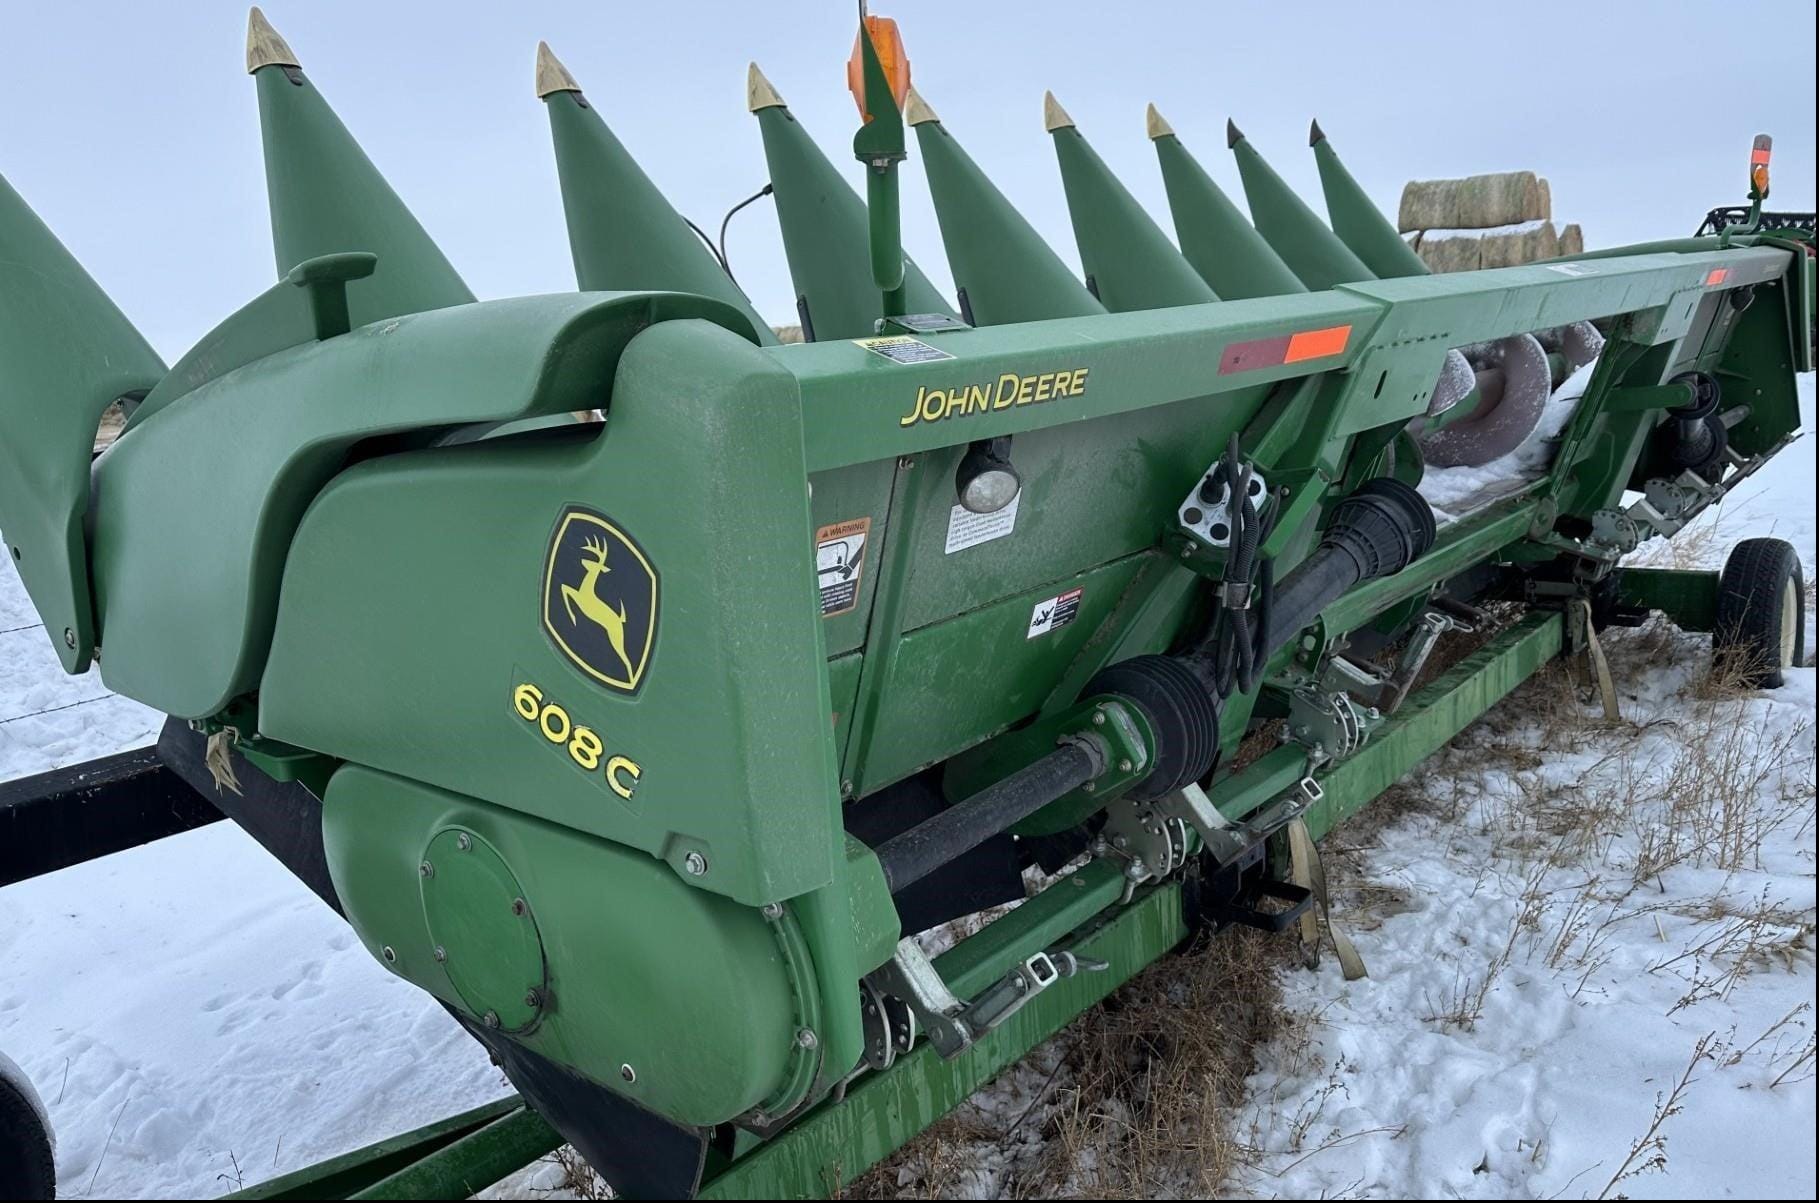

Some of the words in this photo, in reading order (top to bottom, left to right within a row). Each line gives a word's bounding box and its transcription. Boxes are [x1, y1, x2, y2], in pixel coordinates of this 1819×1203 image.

[900, 385, 992, 427] JOHN
[993, 367, 1089, 410] DEERE
[829, 521, 865, 537] WARNING
